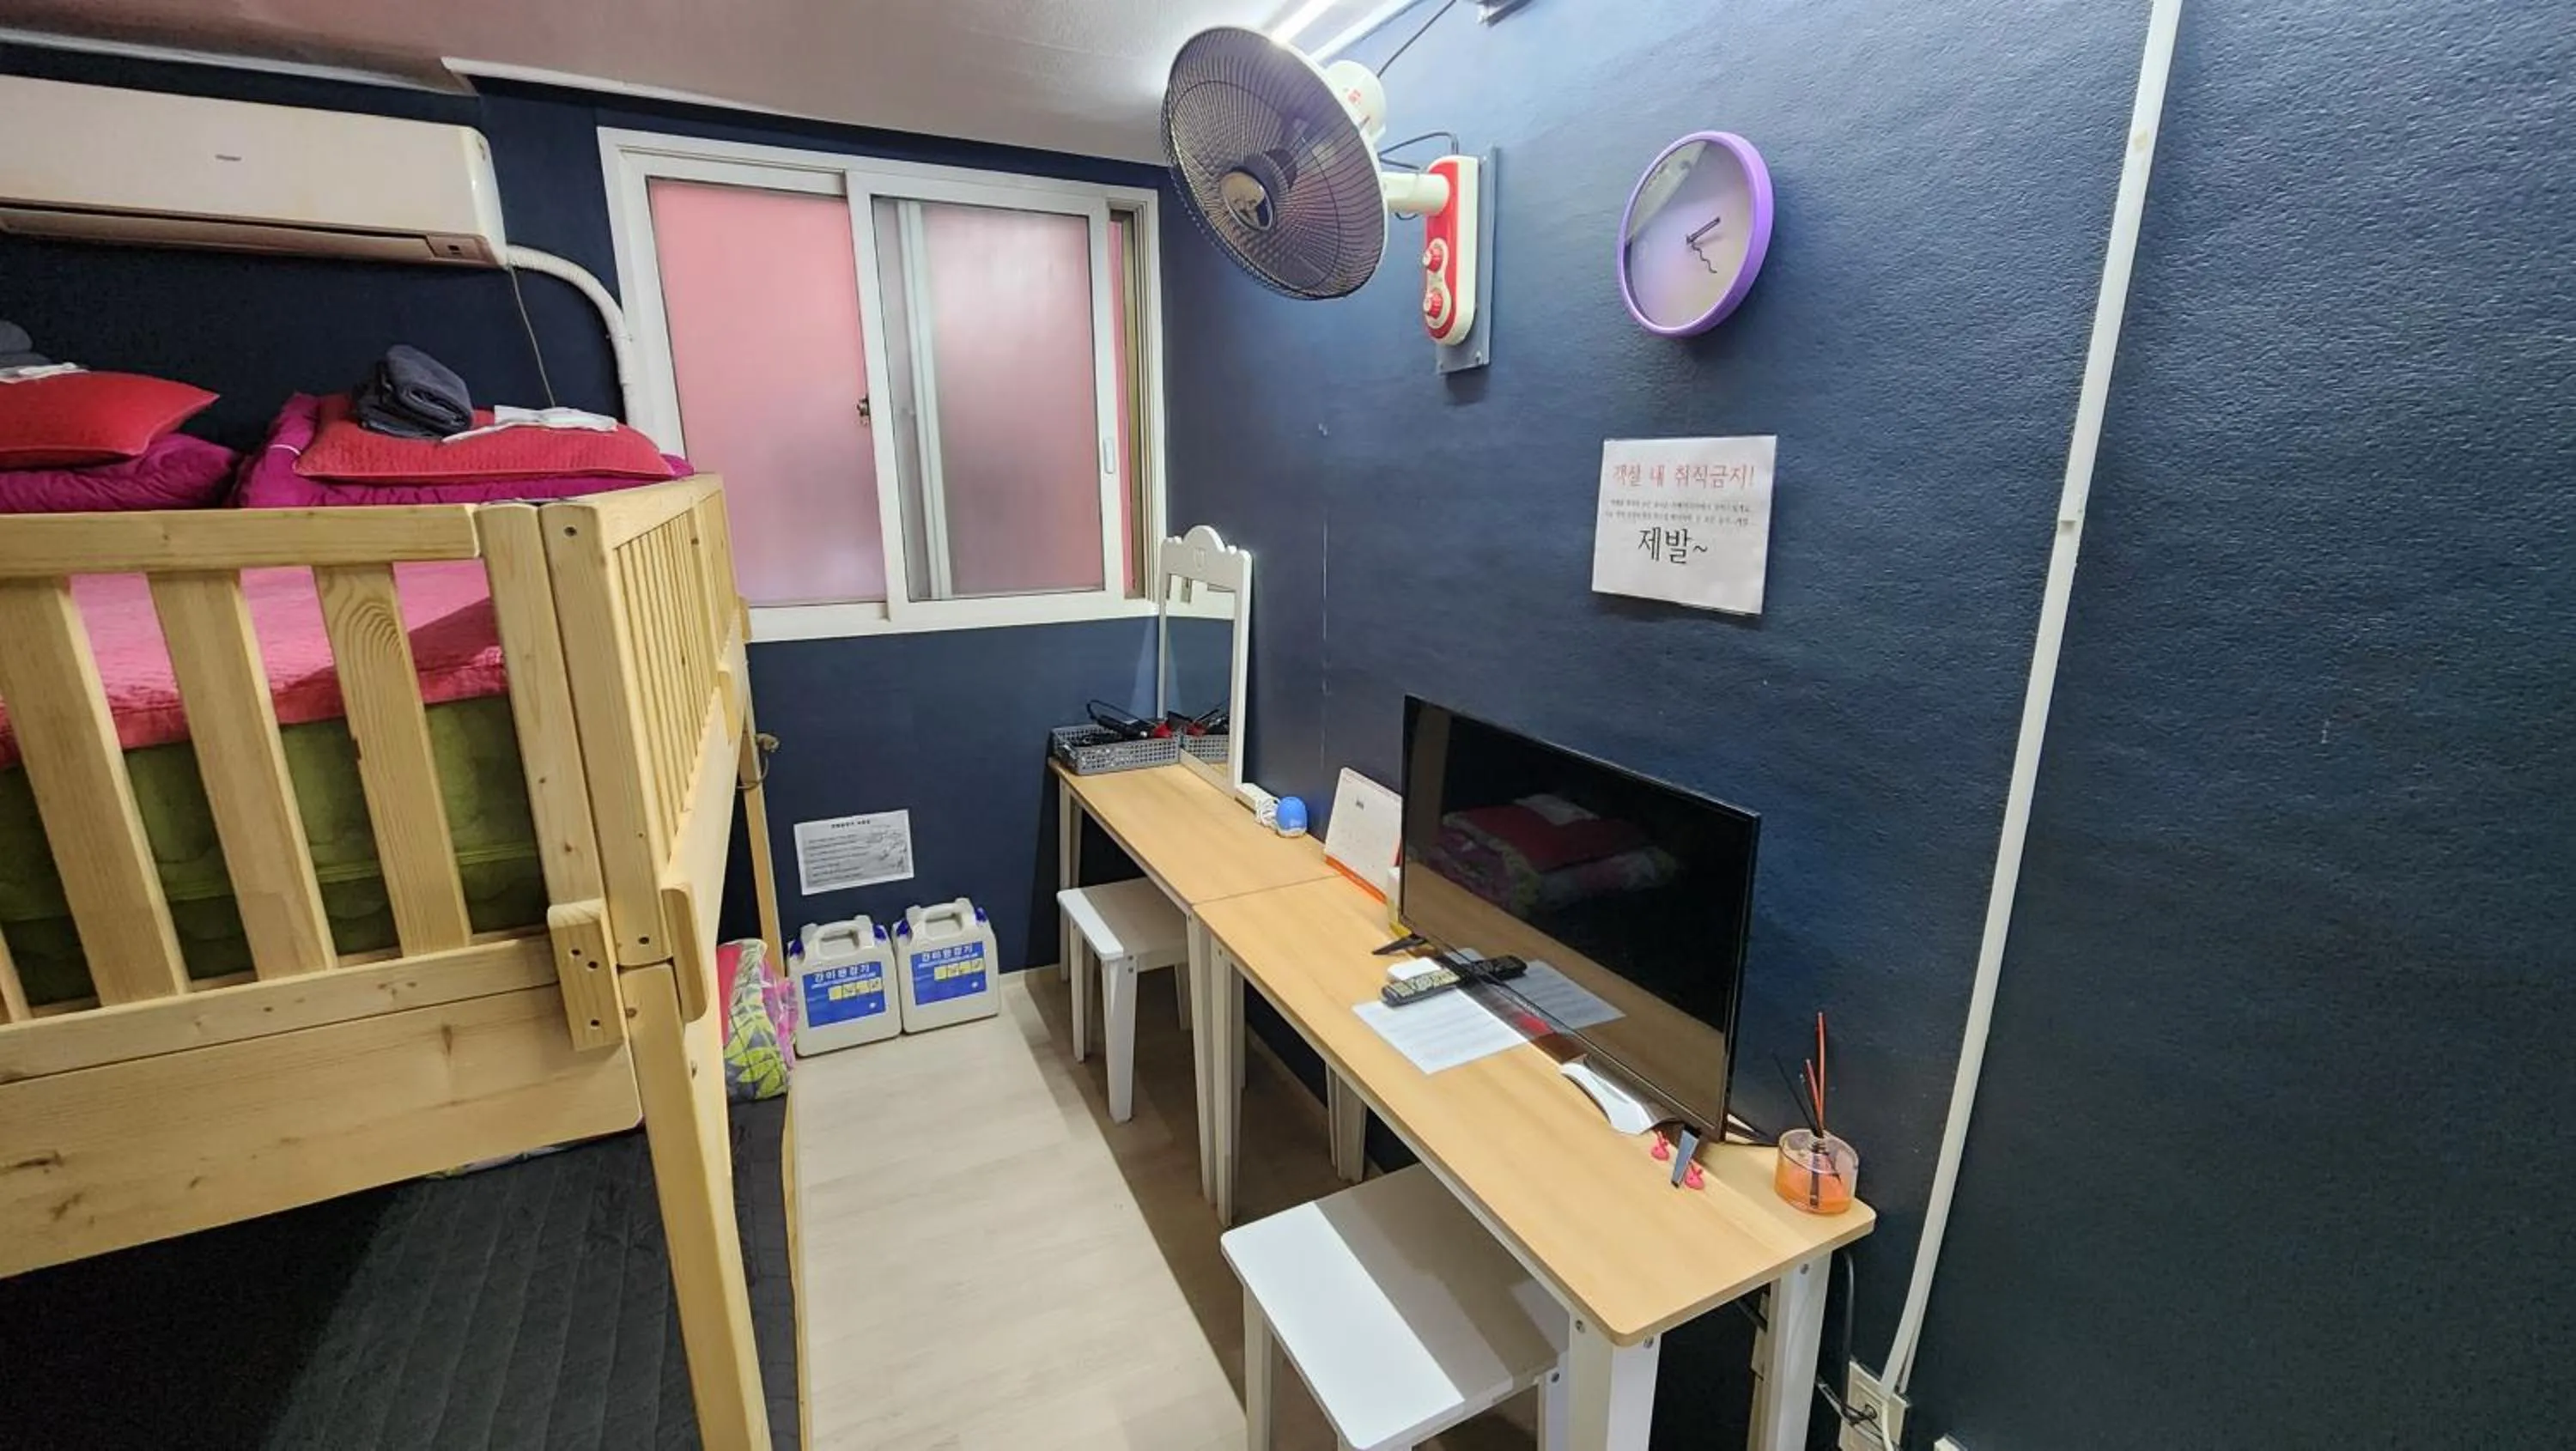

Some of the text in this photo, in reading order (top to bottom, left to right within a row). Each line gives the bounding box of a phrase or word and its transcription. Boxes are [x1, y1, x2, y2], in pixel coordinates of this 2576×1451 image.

[1613, 464, 1755, 489] 객실 내 취식금지!
[1637, 526, 1708, 564] 제발~
